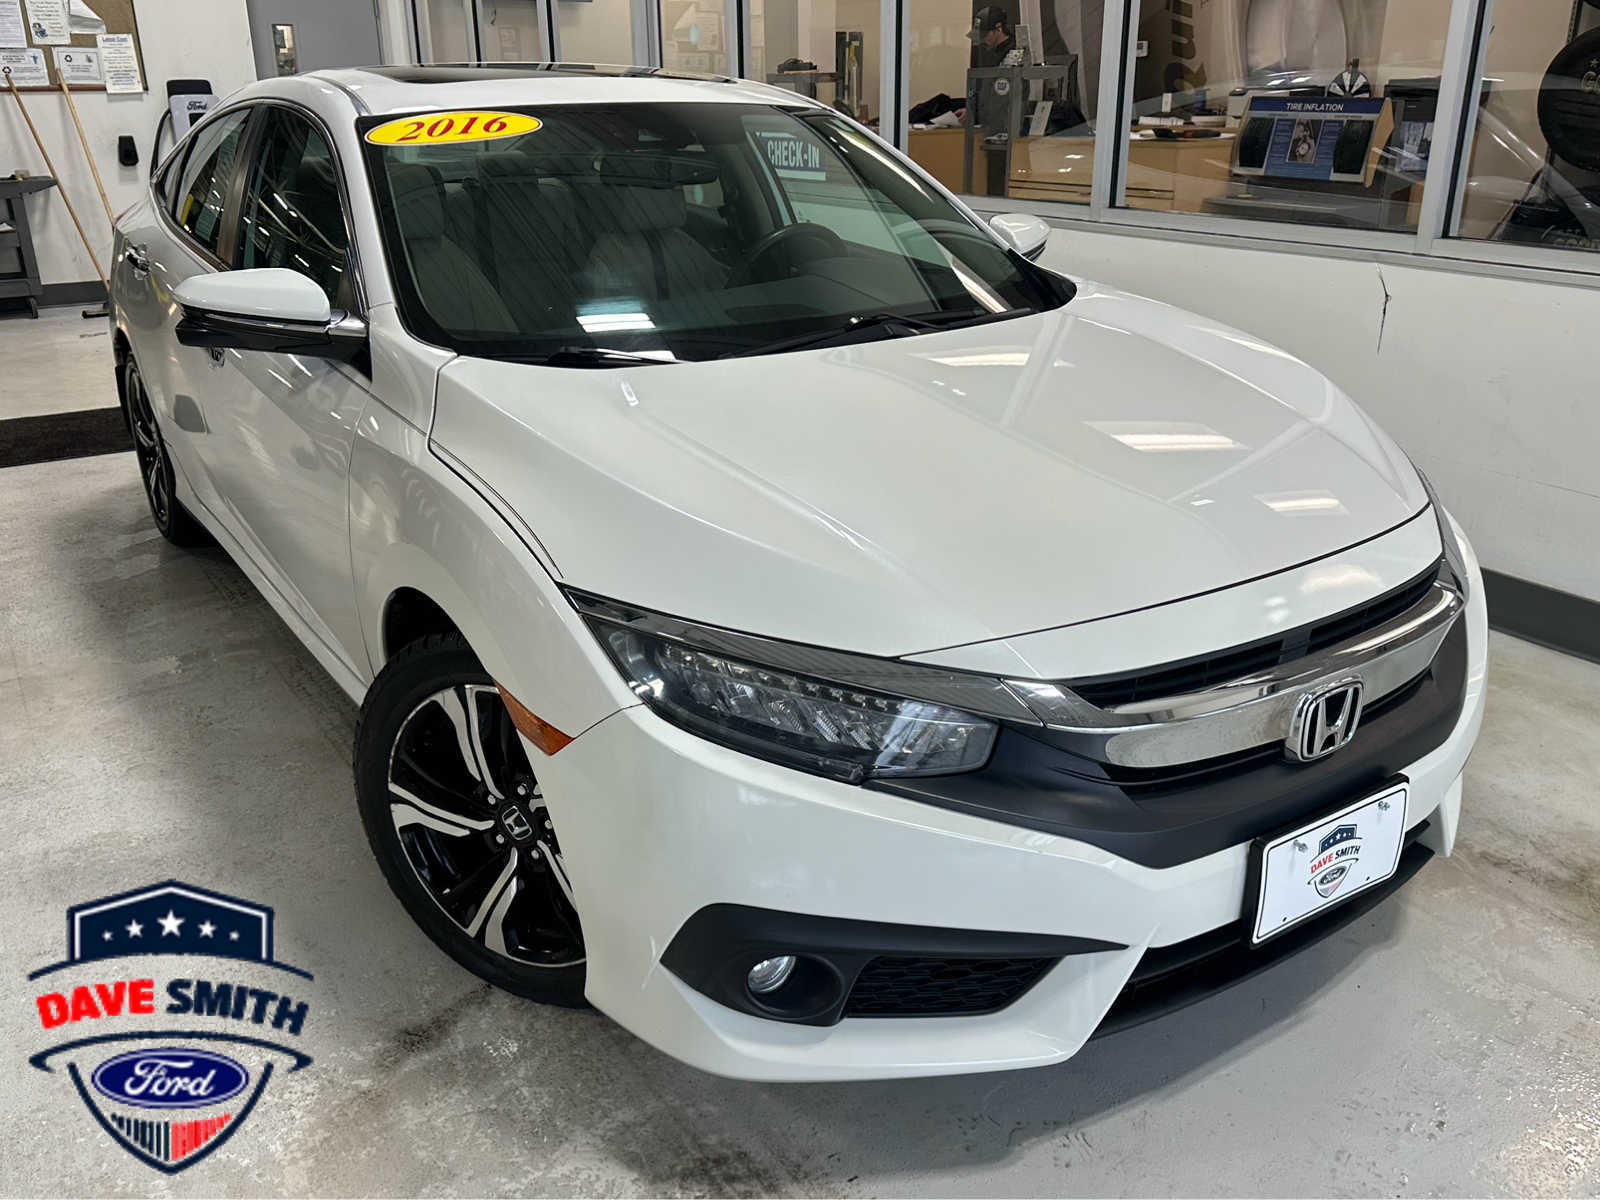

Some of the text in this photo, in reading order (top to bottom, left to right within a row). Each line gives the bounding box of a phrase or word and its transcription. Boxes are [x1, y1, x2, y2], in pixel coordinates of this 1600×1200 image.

[1286, 103, 1344, 112] TIRE INFLATION
[397, 115, 508, 142] 2016
[767, 139, 820, 169] CHECK-IN
[1310, 845, 1361, 875] DAVE SMITH
